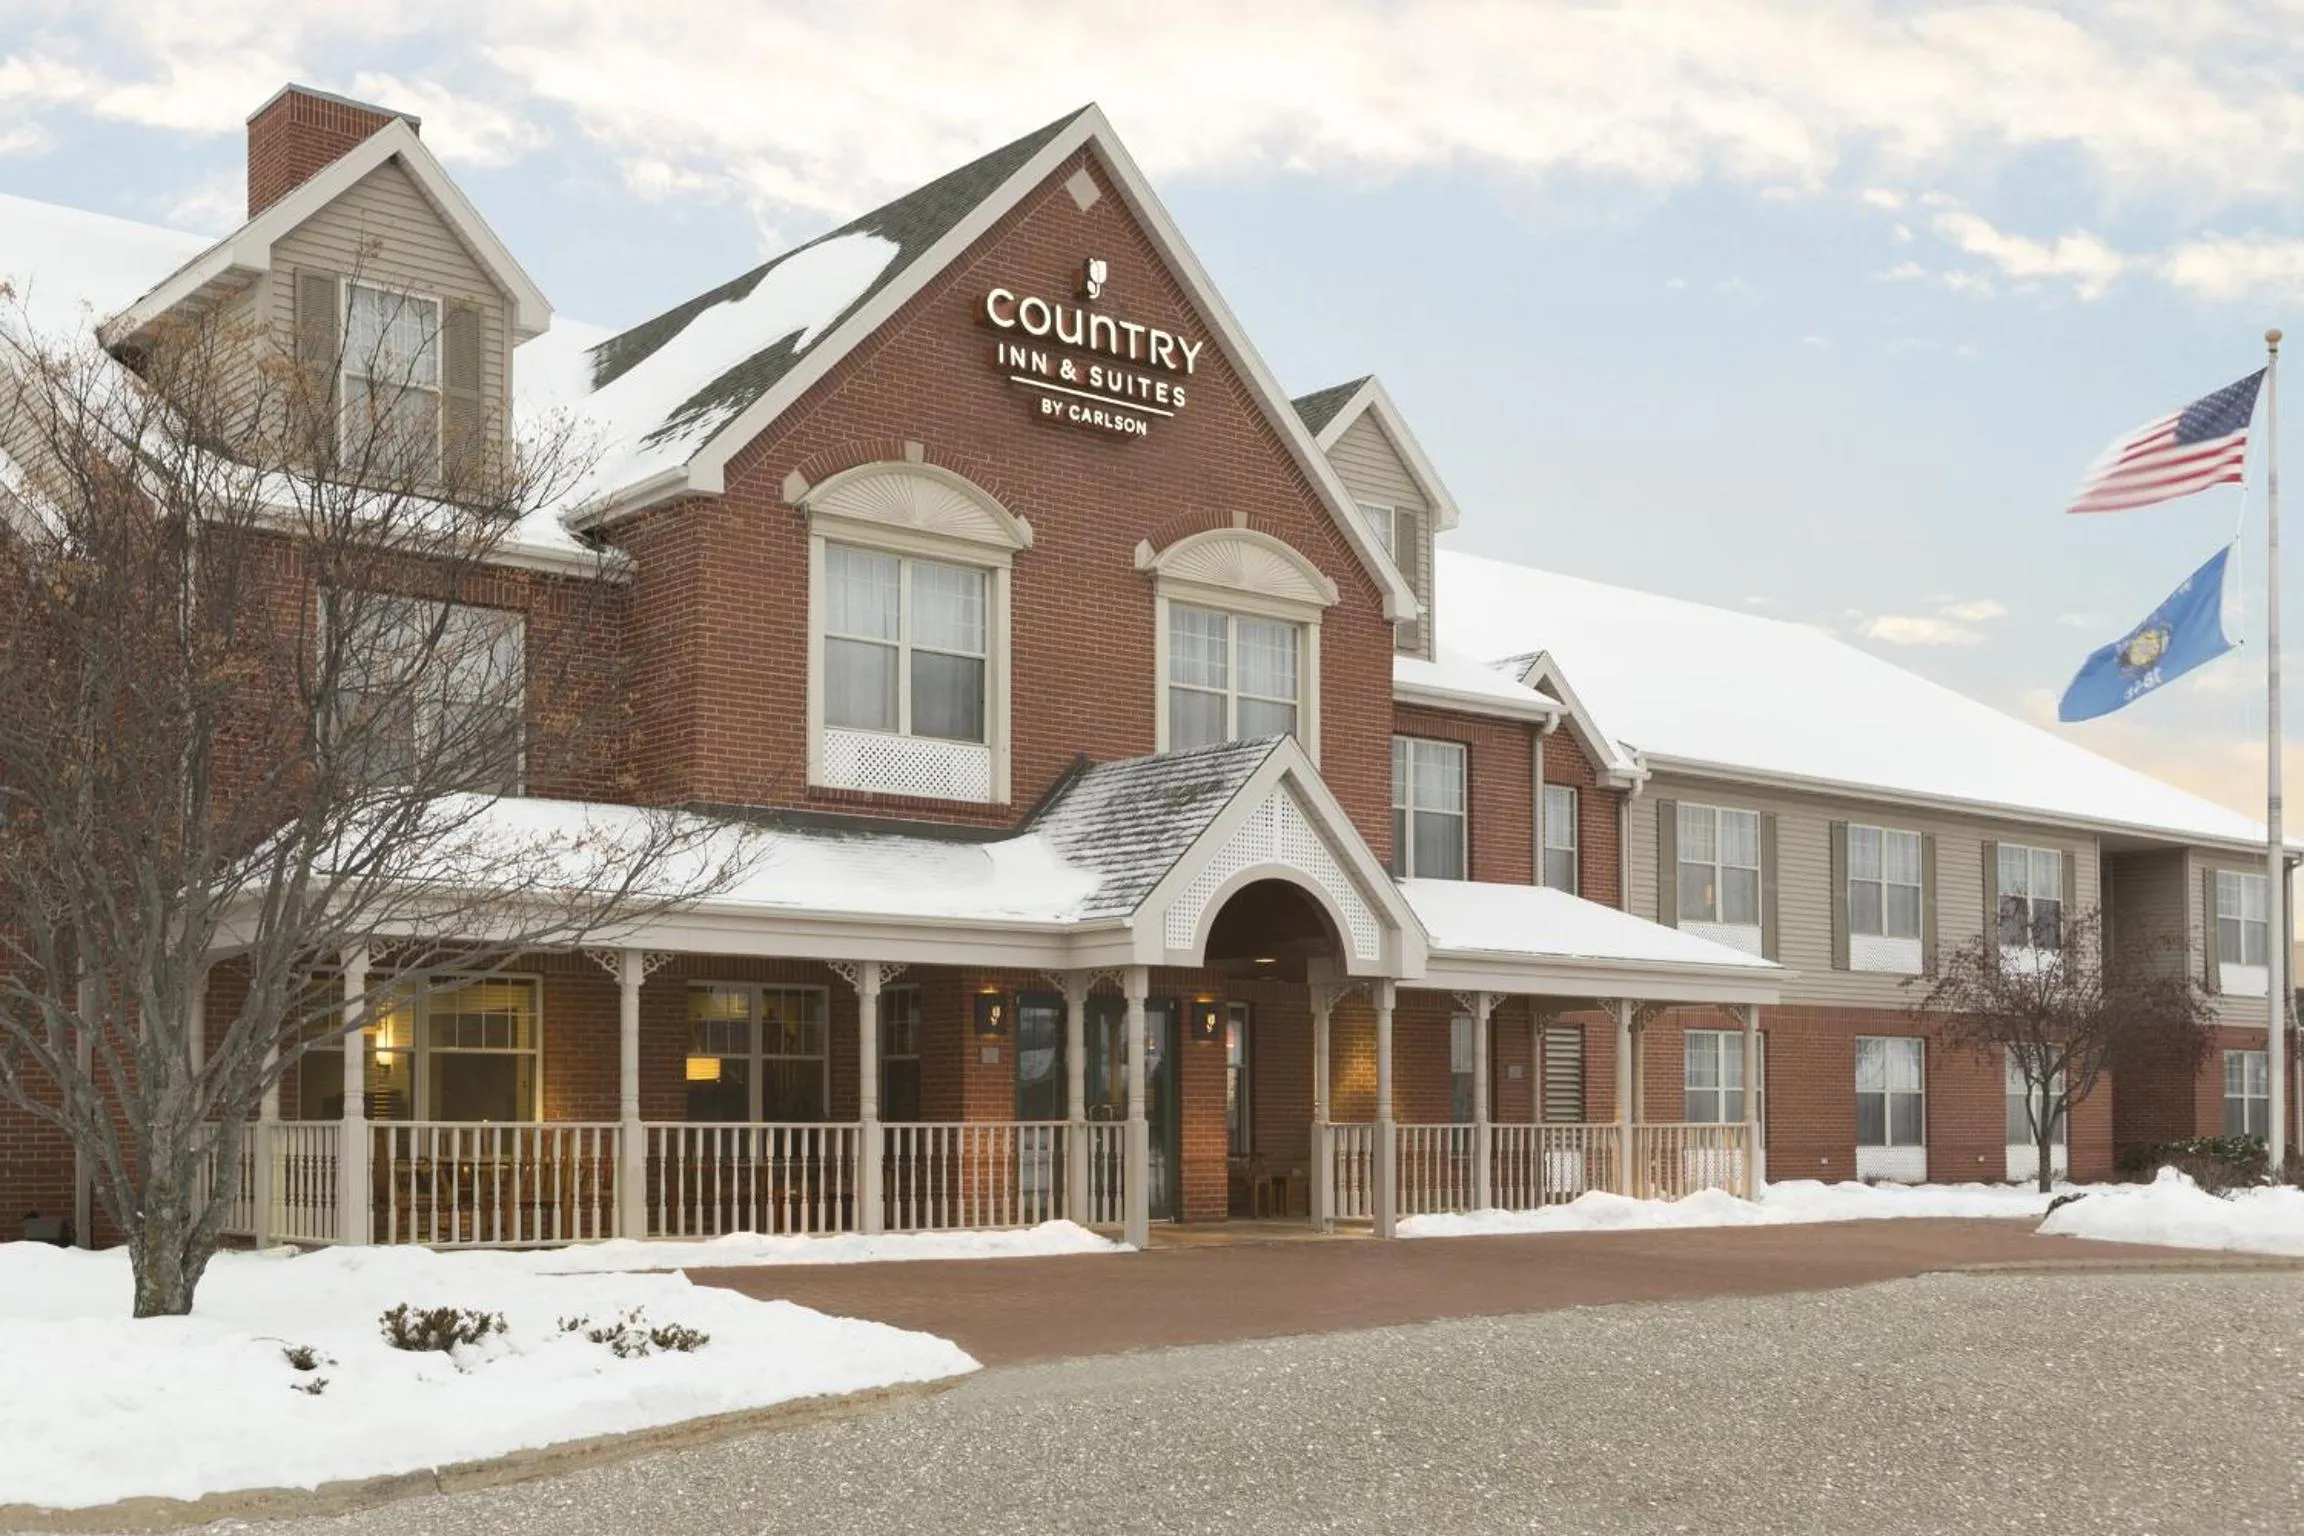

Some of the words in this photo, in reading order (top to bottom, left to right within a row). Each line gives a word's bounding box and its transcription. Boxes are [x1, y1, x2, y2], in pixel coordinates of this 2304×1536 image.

[999, 343, 1048, 374] INN
[1060, 359, 1078, 381] &
[1089, 366, 1186, 408] SUITES
[1041, 398, 1063, 416] BY
[1069, 405, 1147, 436] CARLSON
